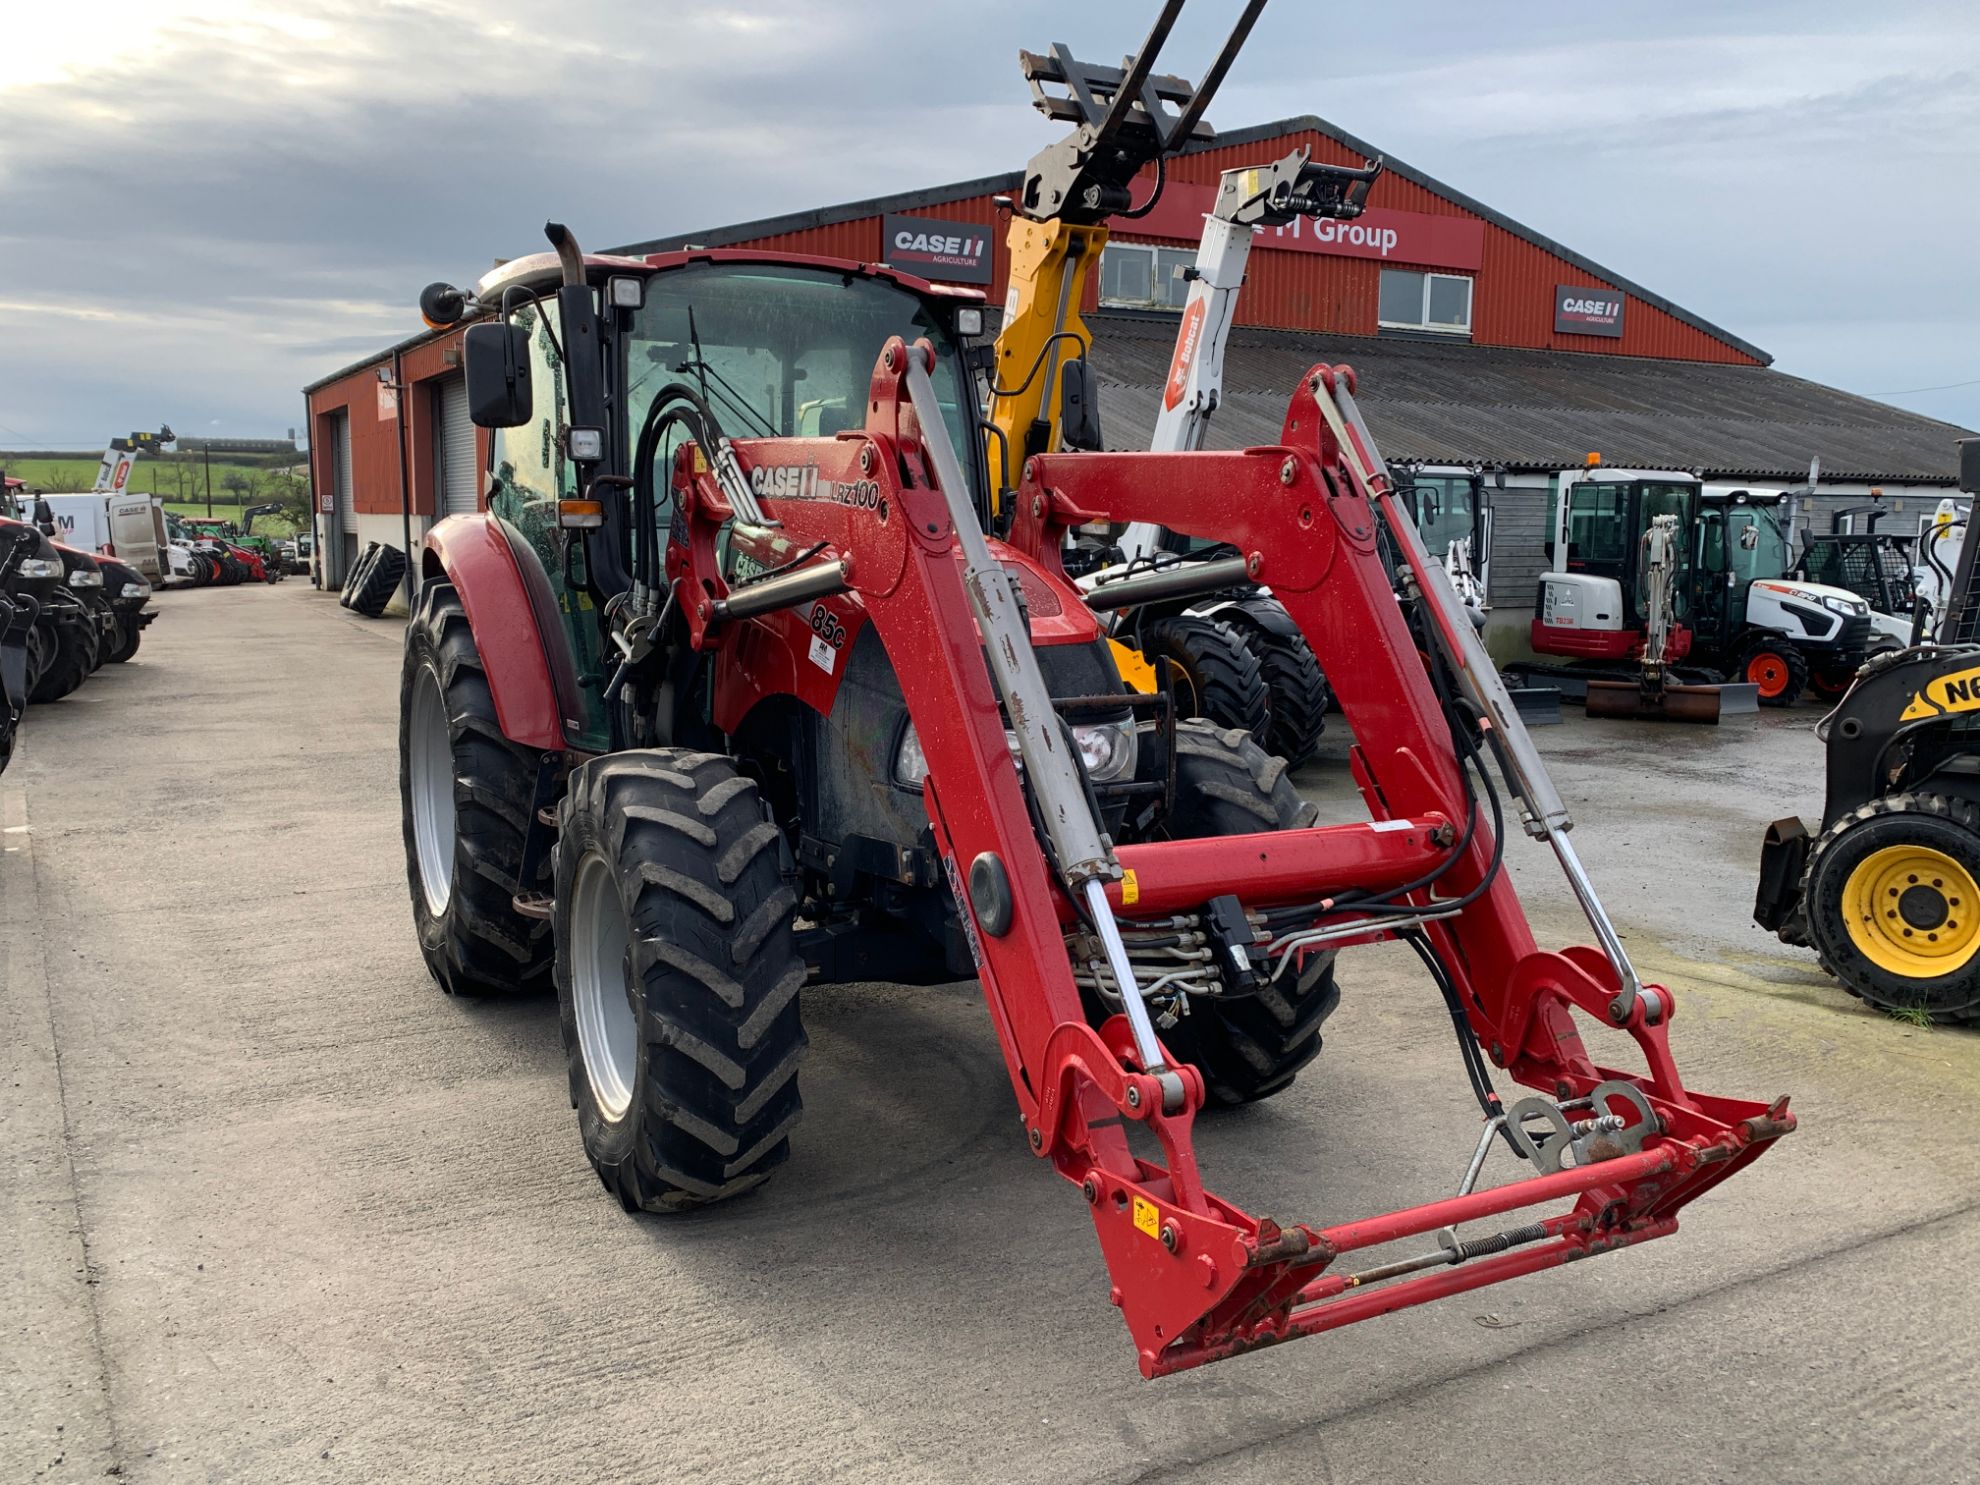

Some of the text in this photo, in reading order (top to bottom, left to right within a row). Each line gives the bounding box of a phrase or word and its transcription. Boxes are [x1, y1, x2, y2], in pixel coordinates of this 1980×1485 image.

[894, 231, 962, 255] CASE
[1313, 216, 1398, 257] Group
[932, 255, 977, 266] AGRICULTURE
[1563, 297, 1606, 316] CASE
[1585, 315, 1615, 324] AGRICULTURE
[1180, 314, 1200, 364] Bobcat
[750, 464, 801, 499] CASE
[830, 480, 880, 512] LRZ100
[810, 604, 847, 649] 85C
